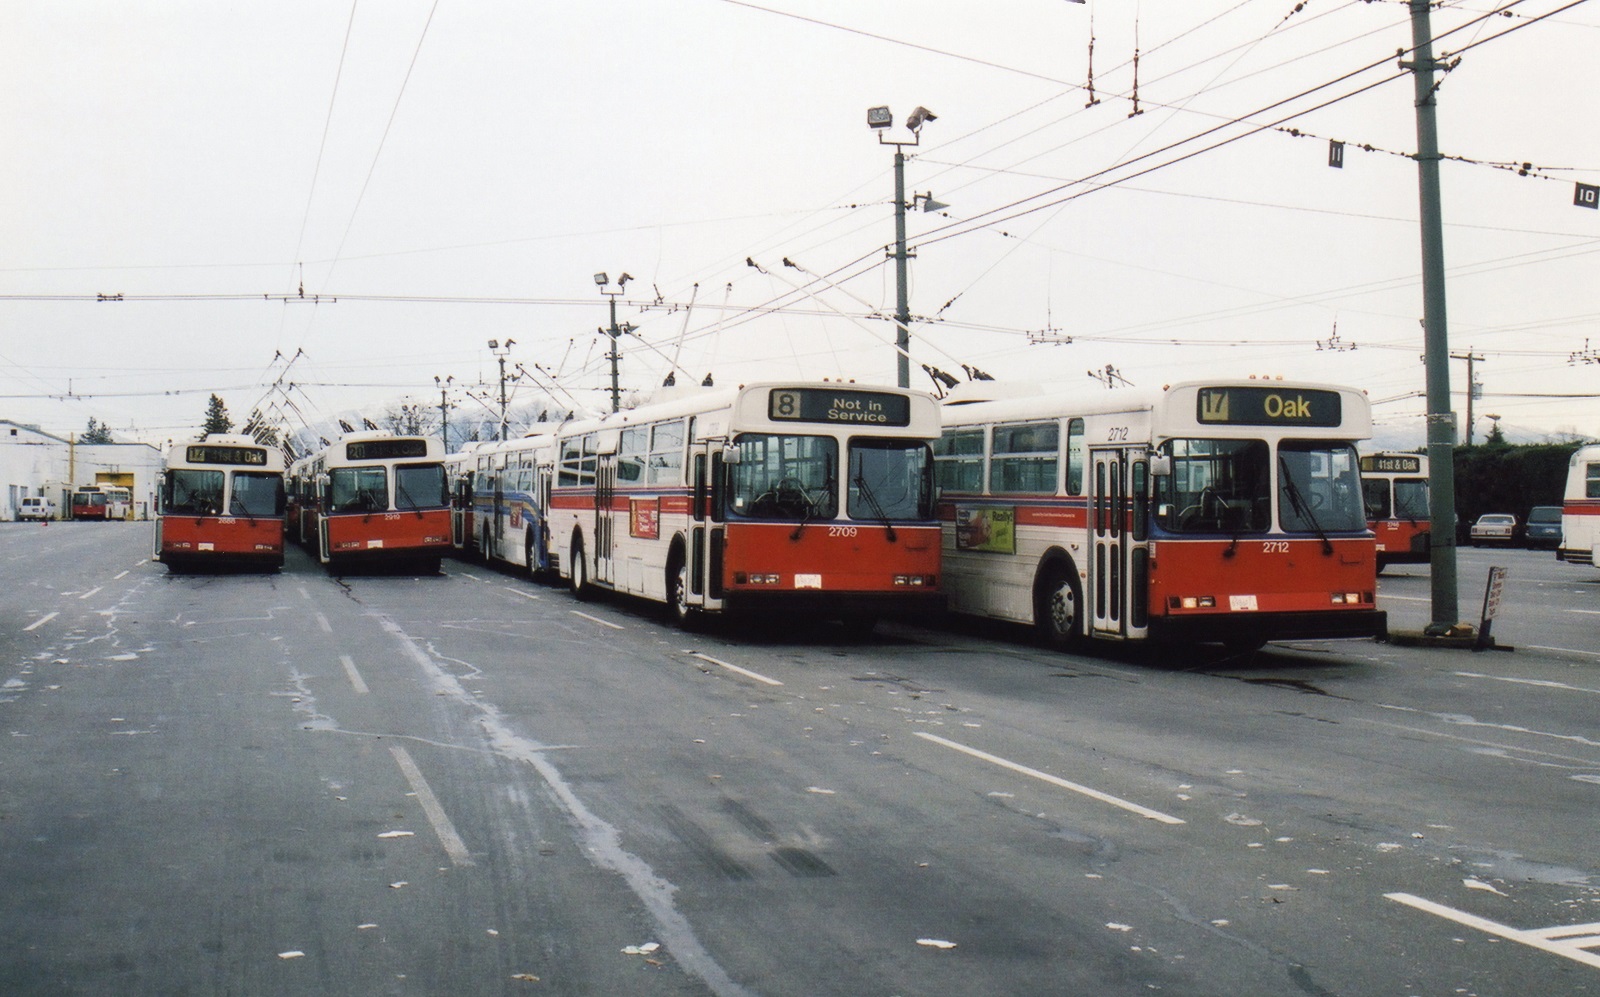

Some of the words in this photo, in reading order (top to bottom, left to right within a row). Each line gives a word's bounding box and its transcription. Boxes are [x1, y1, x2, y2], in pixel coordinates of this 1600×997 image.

[1332, 147, 1341, 162] 11
[1579, 189, 1595, 203] 10
[778, 393, 795, 416] 8
[833, 398, 861, 411] Not
[868, 400, 882, 411] in
[1203, 391, 1227, 413] 17
[1264, 394, 1311, 418] Oak
[827, 408, 888, 423] Service
[1107, 426, 1129, 441] 2712
[244, 451, 264, 463] Oak
[1378, 459, 1393, 470] 41st
[1394, 459, 1401, 470] &
[1402, 459, 1417, 470] Oak
[828, 526, 858, 537] 2709
[1263, 541, 1290, 553] 2712
